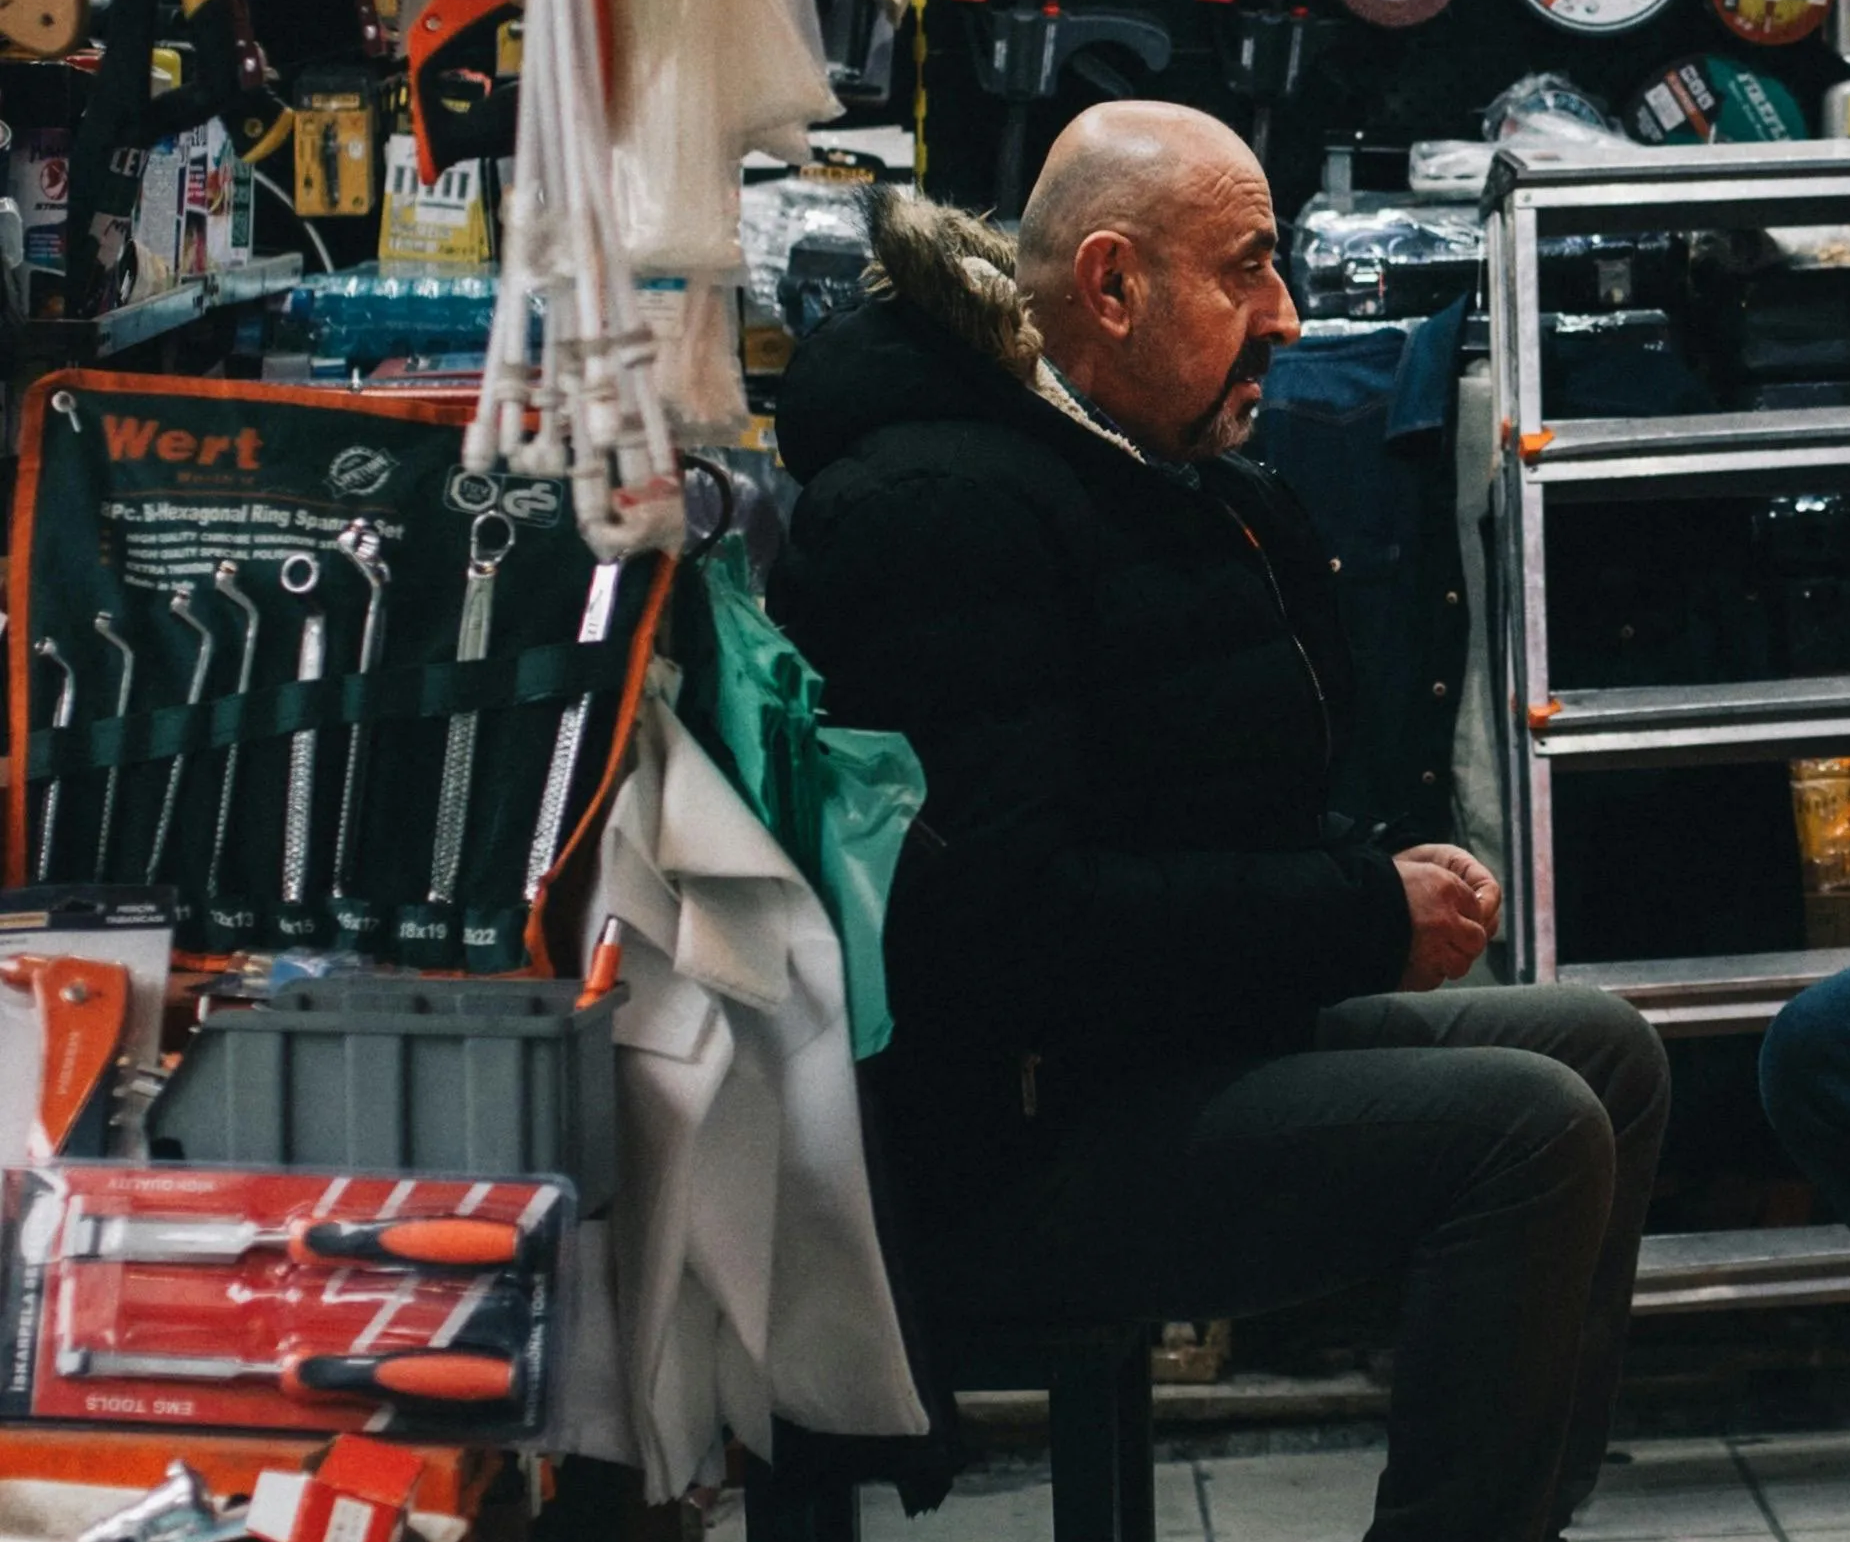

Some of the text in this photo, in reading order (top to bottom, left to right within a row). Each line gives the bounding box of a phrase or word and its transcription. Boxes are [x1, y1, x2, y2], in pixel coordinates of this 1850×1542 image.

[103, 414, 265, 471] Wert
[251, 503, 291, 528] Ring
[294, 509, 354, 532] Spann
[399, 920, 448, 940] 18x19
[85, 1396, 195, 1417] EMG TOOLS
